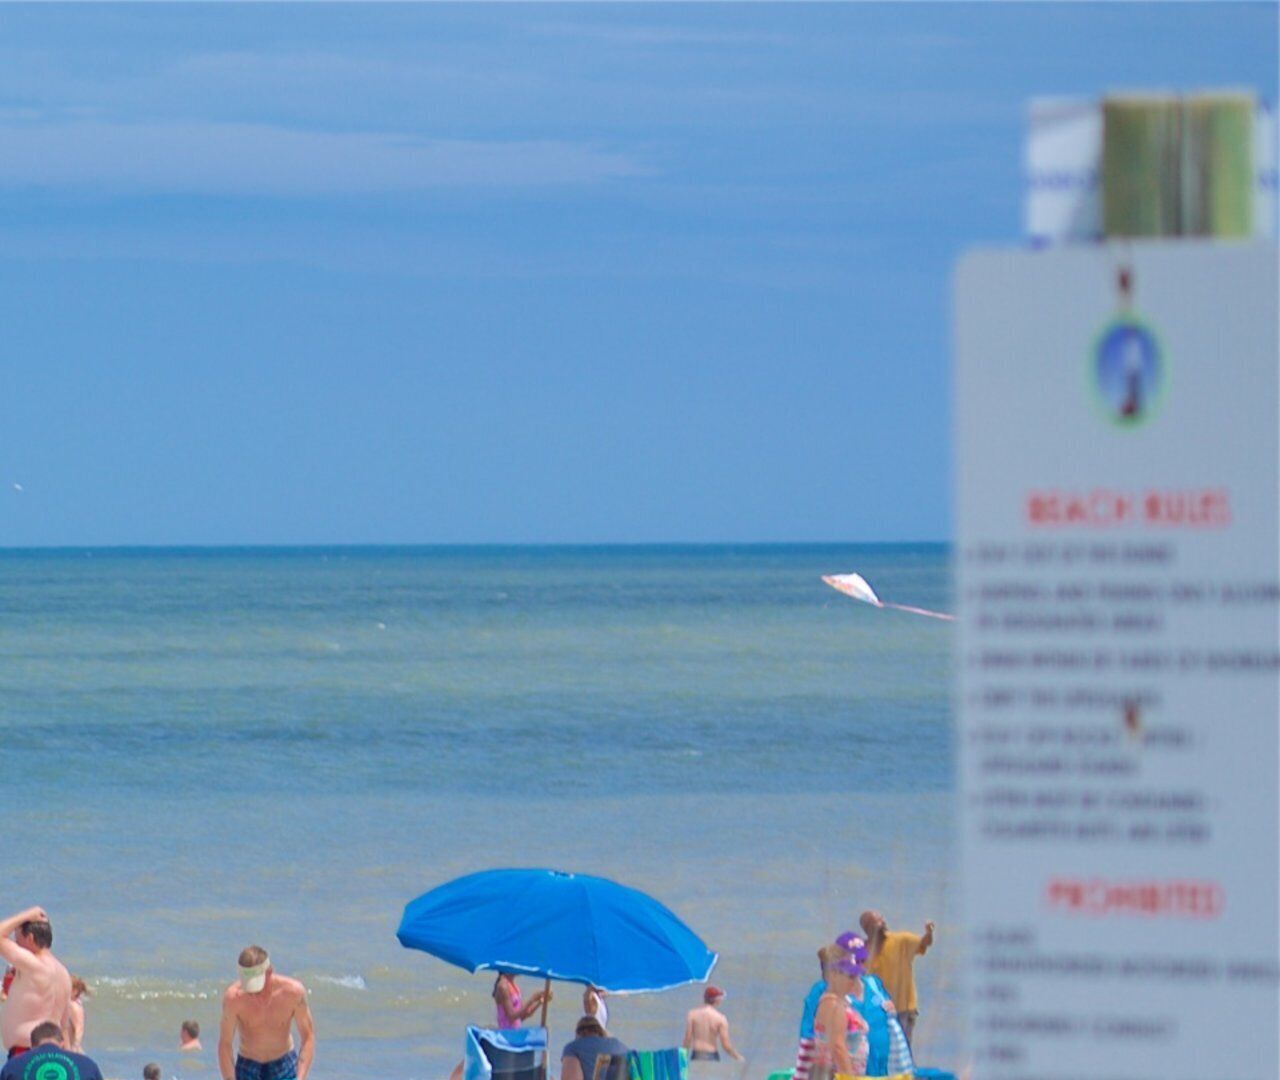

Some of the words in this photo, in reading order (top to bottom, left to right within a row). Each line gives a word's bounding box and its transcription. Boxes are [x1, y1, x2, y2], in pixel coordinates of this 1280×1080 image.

[1026, 491, 1134, 527] BEACH
[1144, 492, 1231, 529] RULES
[1048, 877, 1226, 917] PROHIBITED
